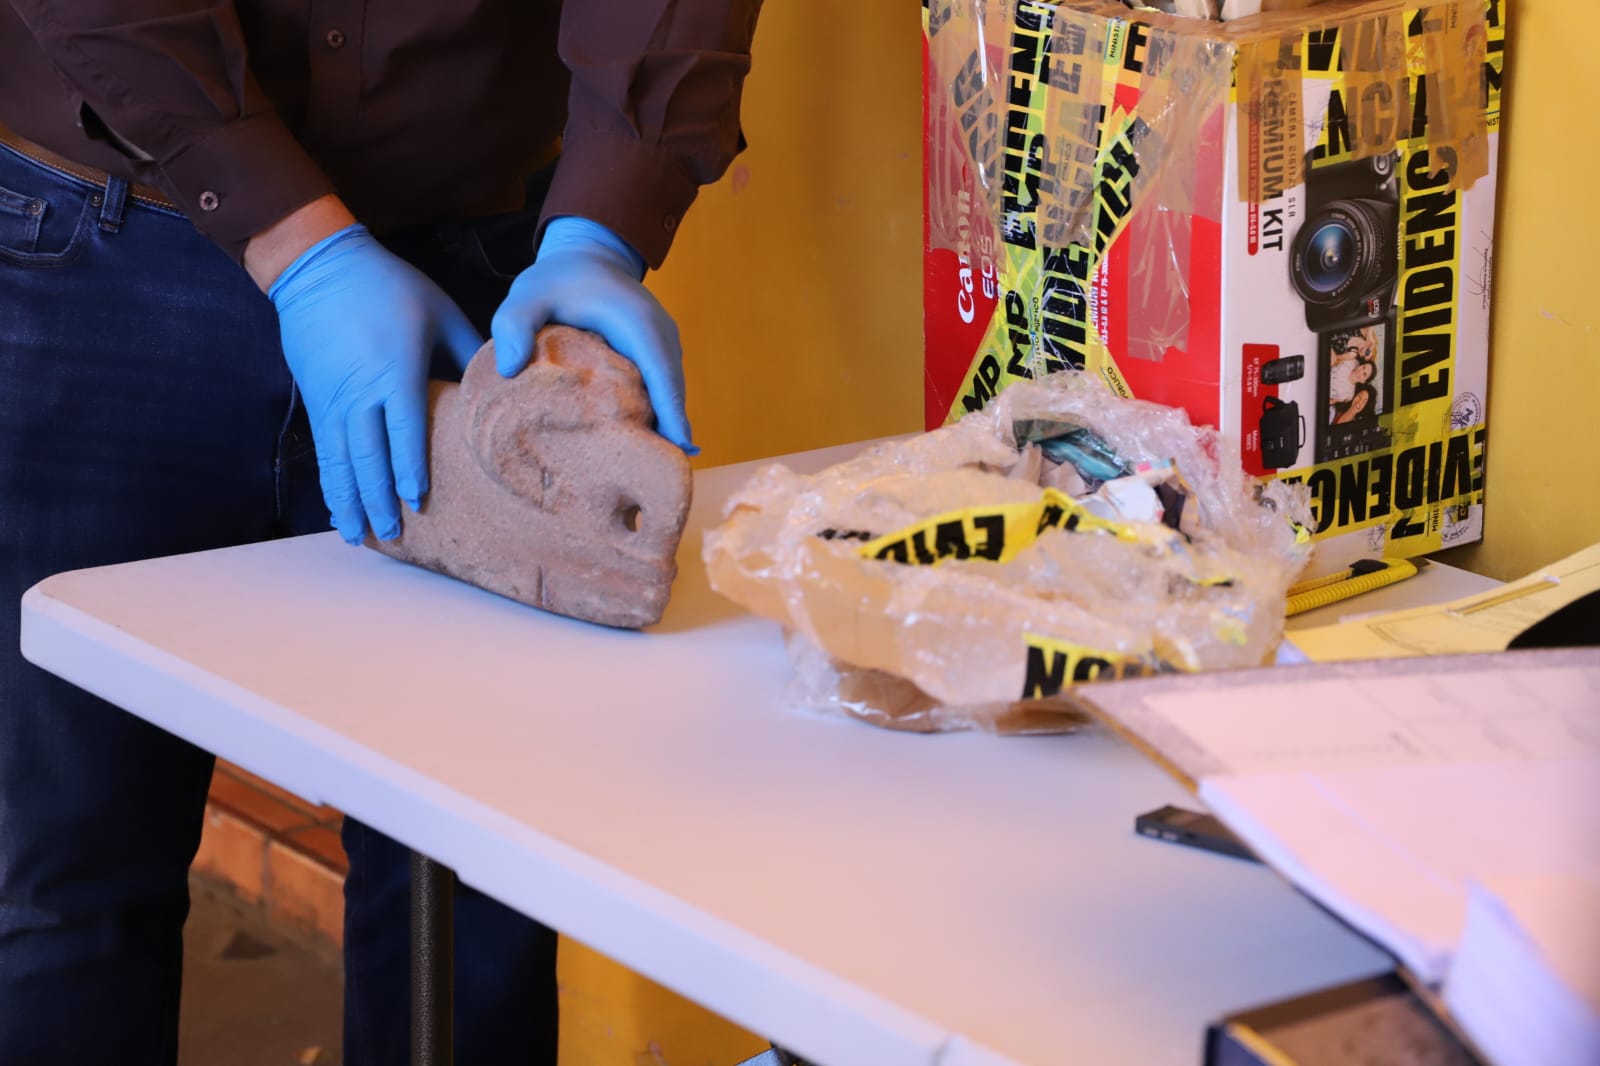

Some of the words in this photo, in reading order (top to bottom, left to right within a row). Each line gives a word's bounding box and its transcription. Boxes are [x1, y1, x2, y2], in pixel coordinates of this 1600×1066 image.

[957, 190, 975, 324] Canon
[980, 233, 995, 299] EOS
[1263, 209, 1283, 251] KIT
[1005, 289, 1034, 380] MP
